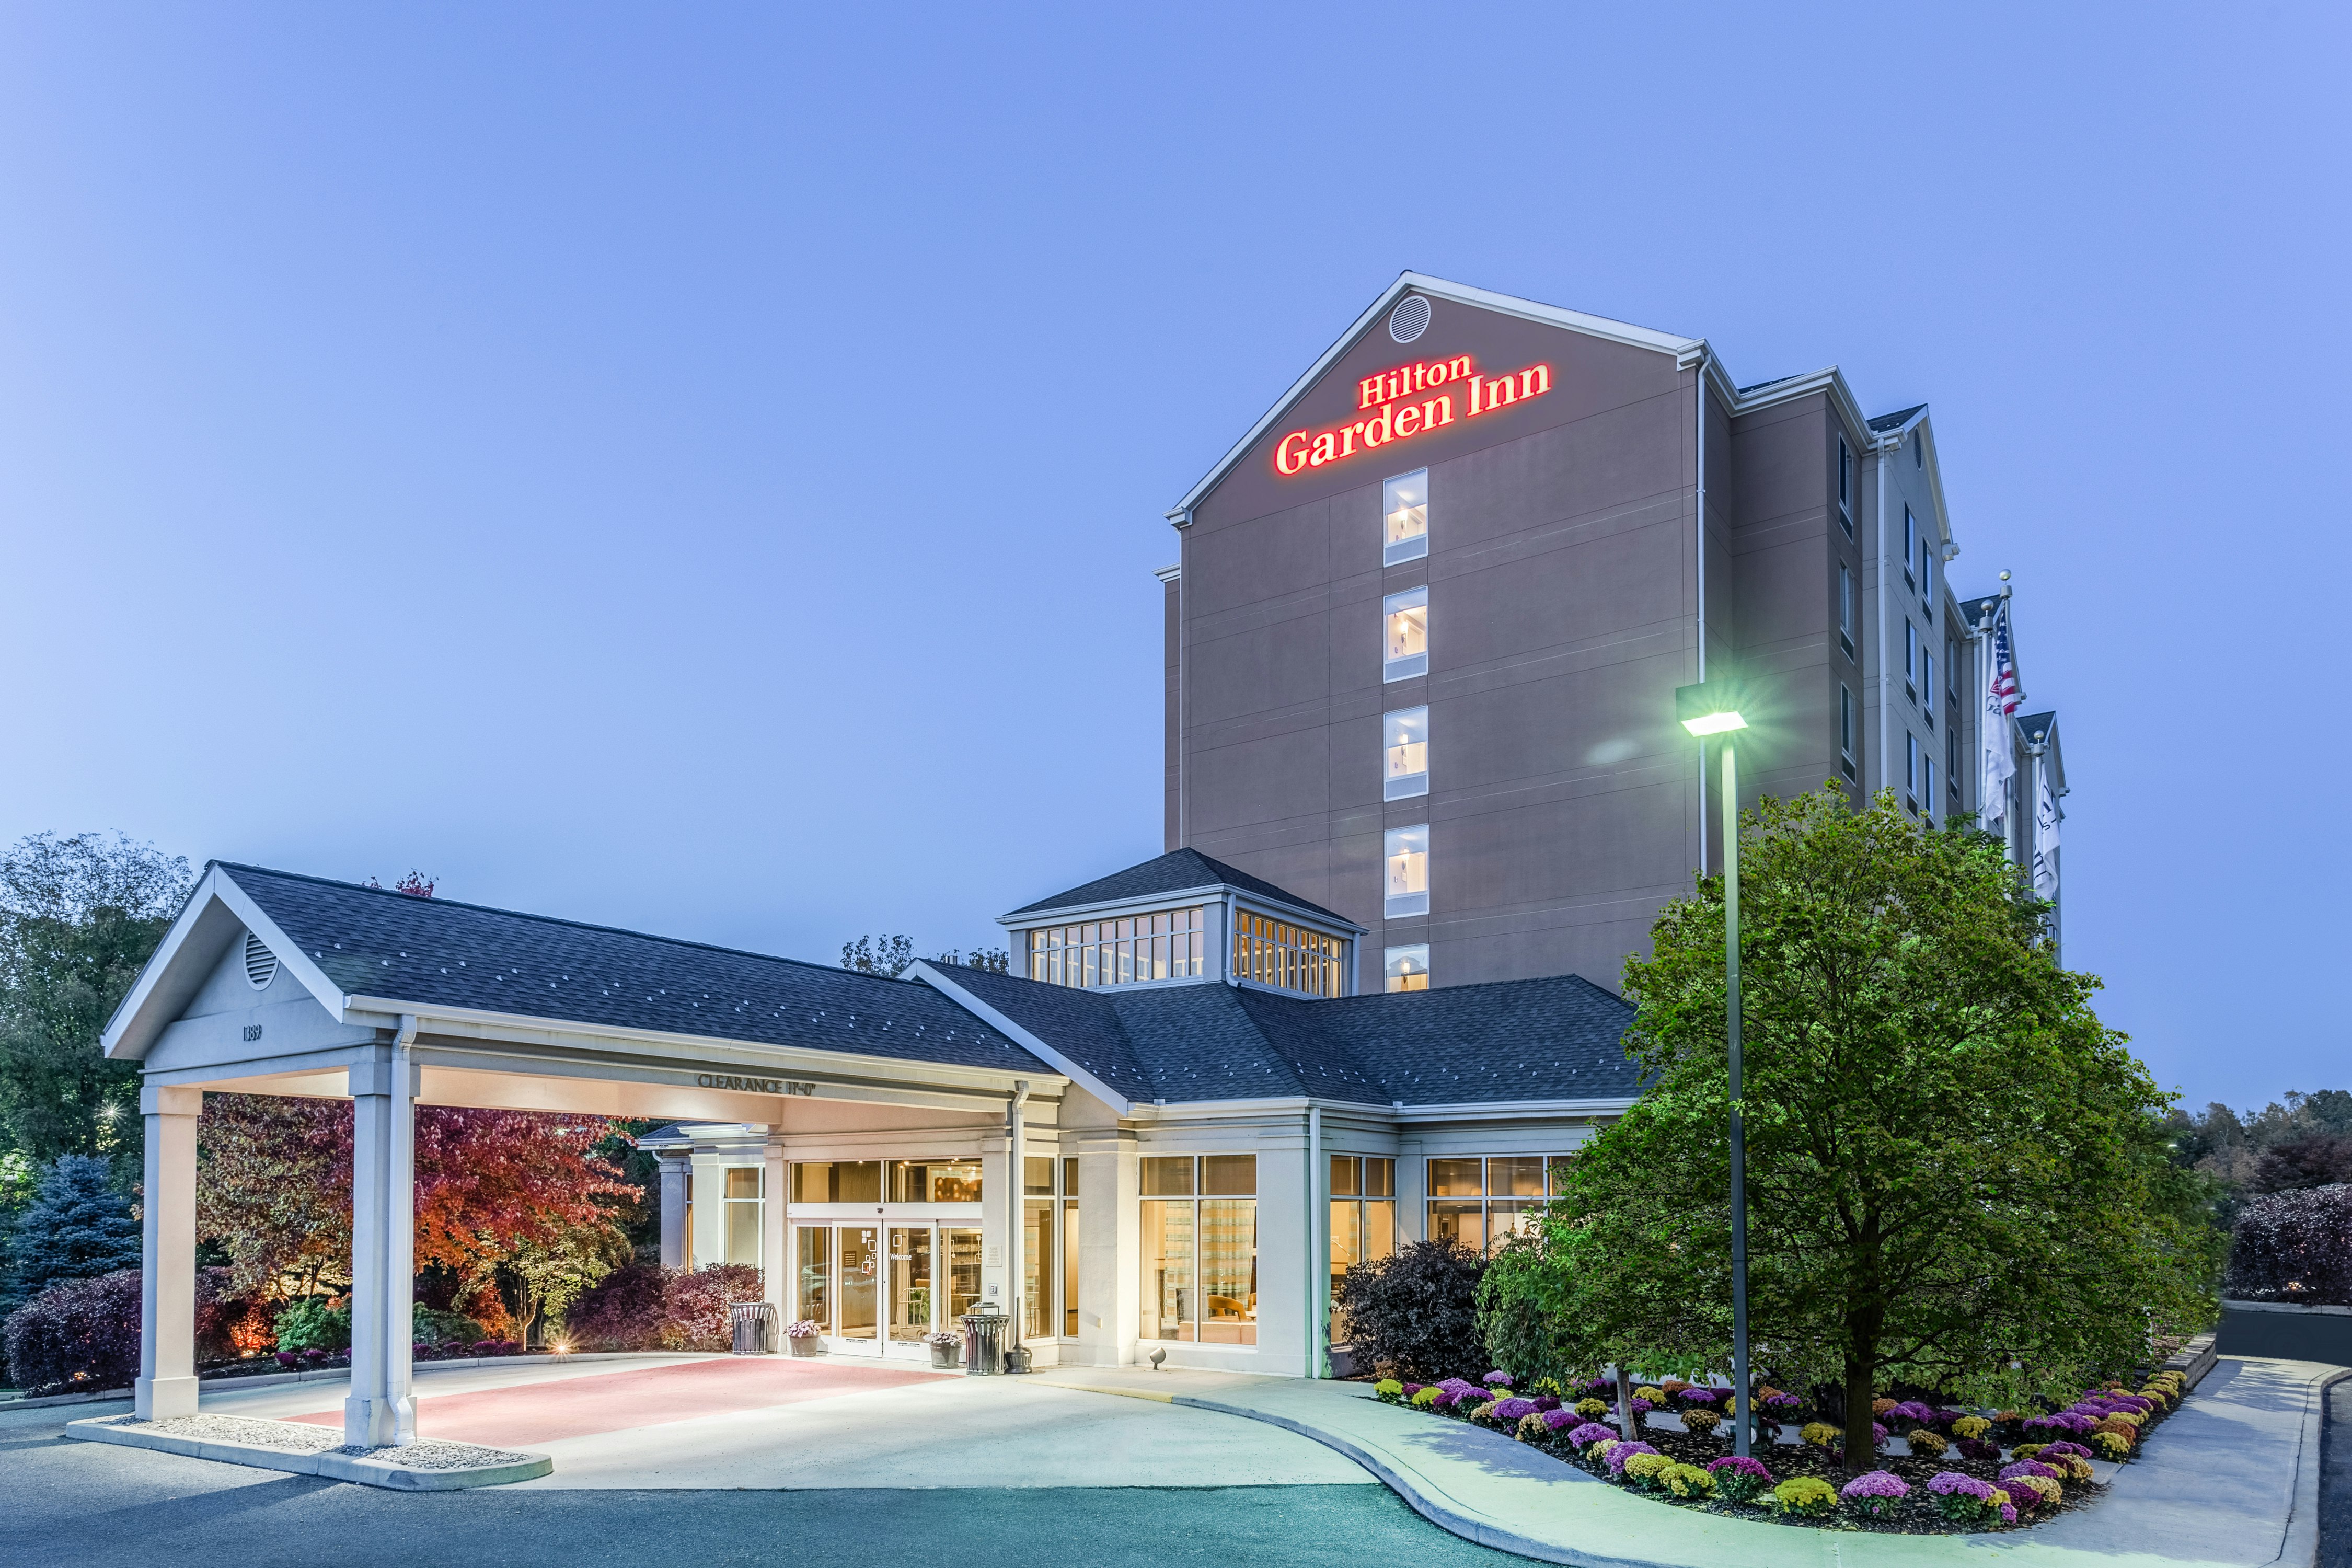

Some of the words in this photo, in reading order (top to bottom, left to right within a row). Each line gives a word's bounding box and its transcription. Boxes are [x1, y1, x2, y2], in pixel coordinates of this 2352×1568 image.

[1359, 354, 1472, 409] Hilton
[1275, 395, 1455, 475] Garden
[1466, 364, 1551, 417] Inn
[243, 1024, 262, 1041] 1389
[698, 1073, 782, 1094] CLEARANCE
